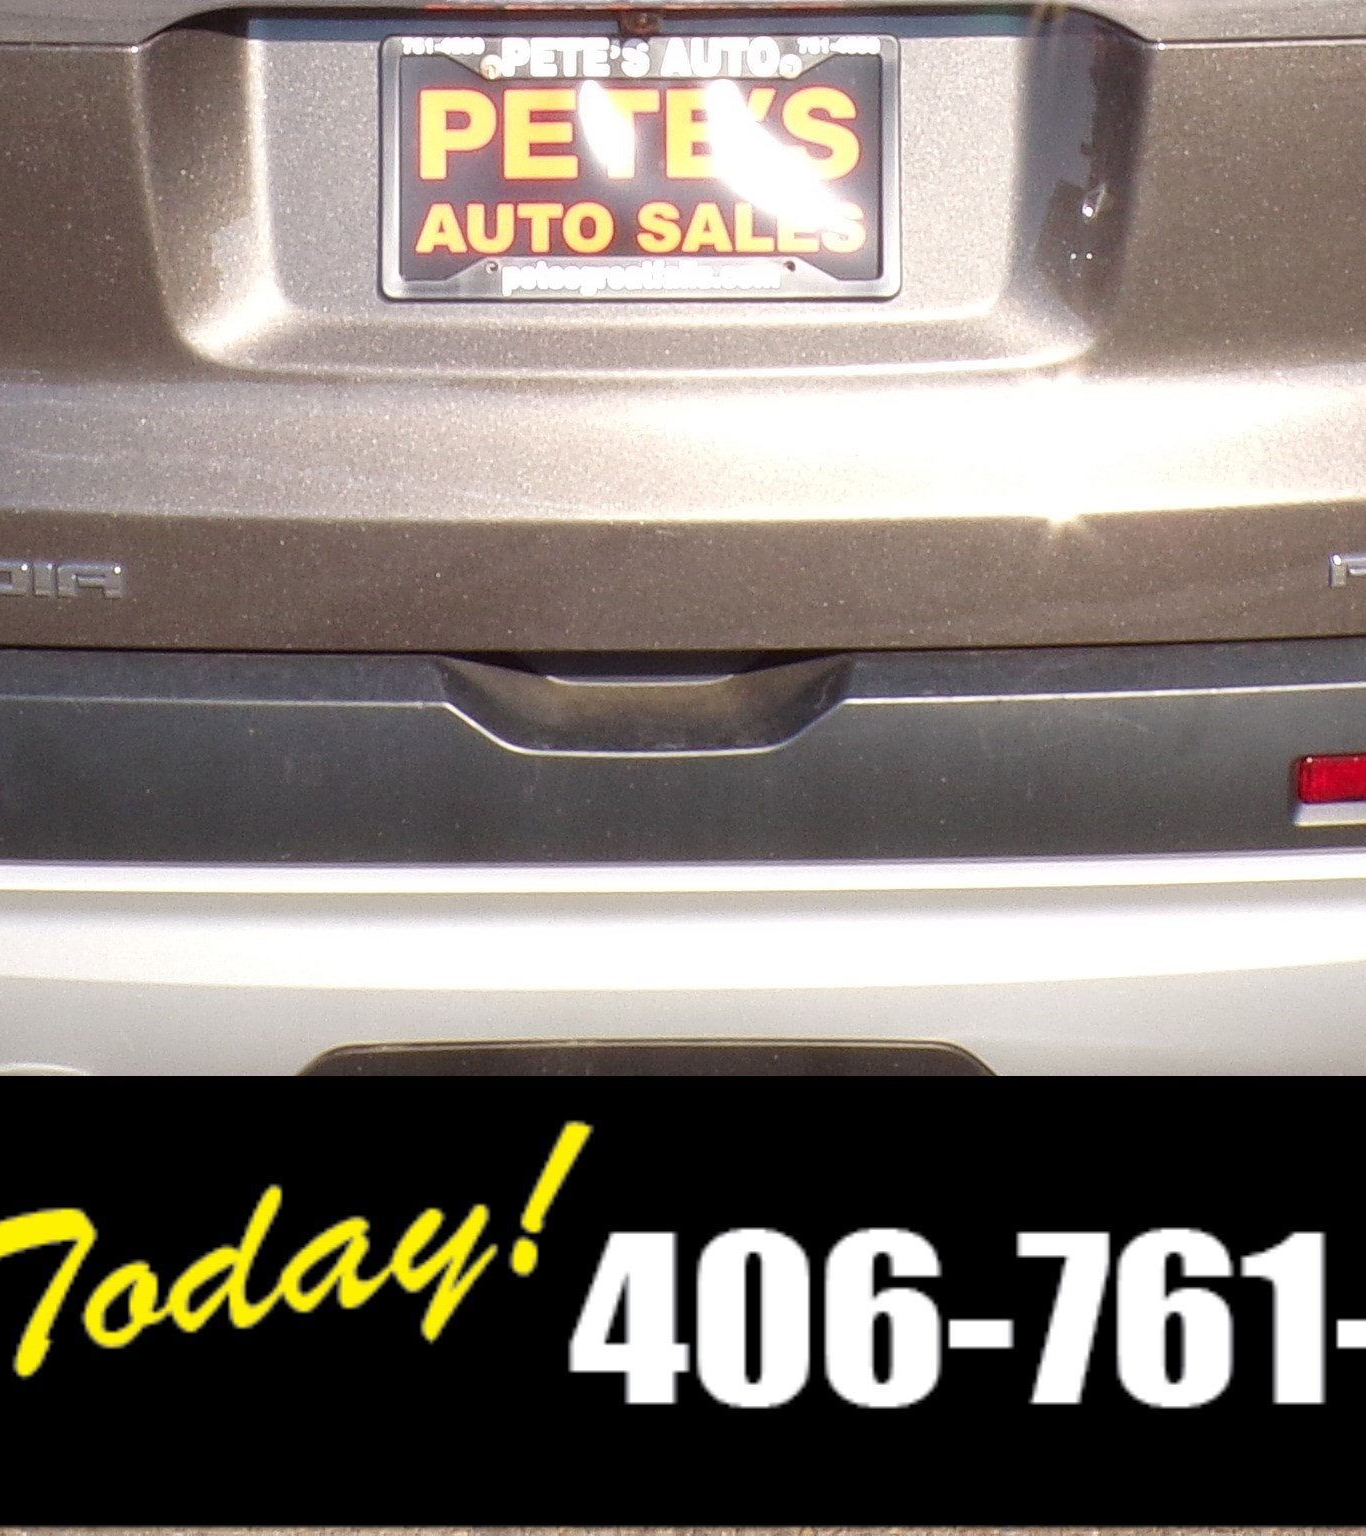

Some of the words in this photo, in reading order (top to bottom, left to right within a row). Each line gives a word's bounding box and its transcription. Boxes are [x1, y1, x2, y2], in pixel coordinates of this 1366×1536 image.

[501, 37, 651, 78] PETE'S
[660, 37, 781, 78] AUTO
[417, 85, 863, 182] PETE'S
[415, 201, 616, 255] AUTO
[636, 201, 868, 255] SALES
